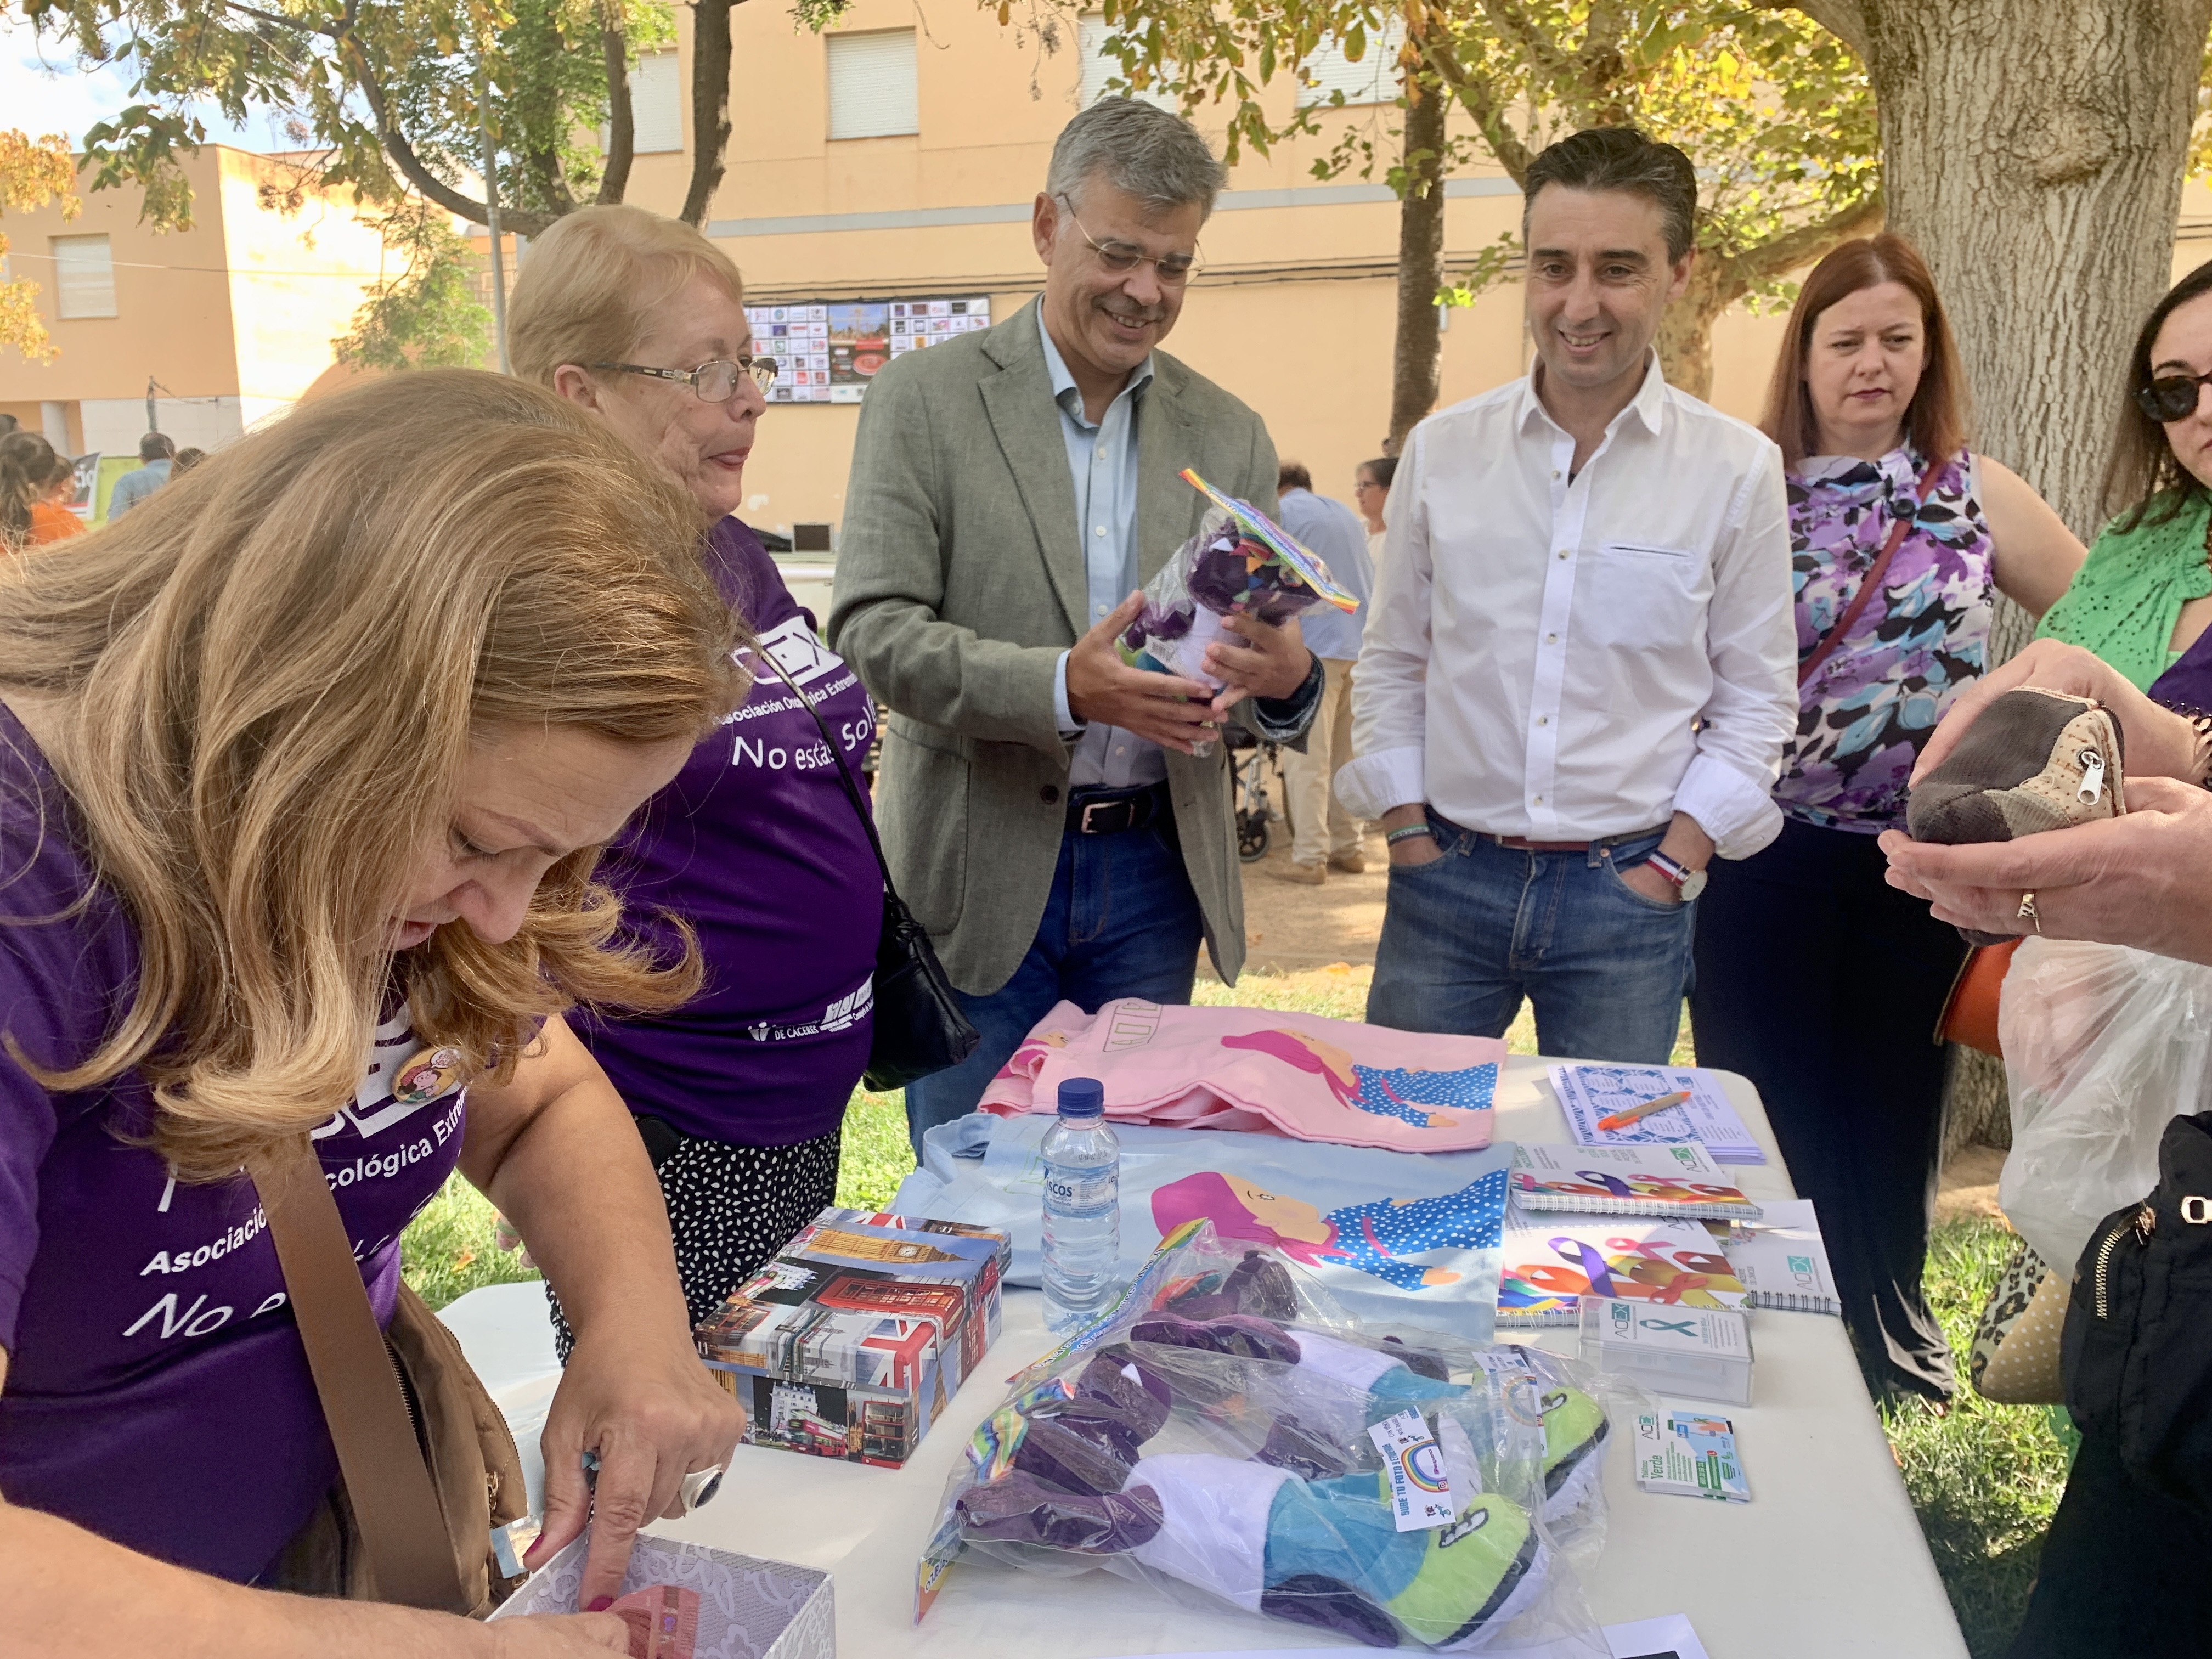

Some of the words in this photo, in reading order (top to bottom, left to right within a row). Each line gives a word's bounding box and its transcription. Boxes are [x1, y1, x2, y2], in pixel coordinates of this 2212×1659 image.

[718, 700, 783, 725] sociación
[732, 736, 787, 770] No
[775, 1030, 786, 1040] DE
[1670, 1147, 1702, 1172] AOEX
[1045, 1172, 1072, 1197] iscos
[139, 1203, 267, 1276] Asociació
[325, 1137, 433, 1191] cológica
[1787, 1256, 1814, 1291] AOEX
[122, 1293, 234, 1339] No
[1612, 1303, 1630, 1339] AOEX
[1393, 1466, 1403, 1484] FOTO
[1649, 1455, 1663, 1479] Verde
[1396, 1485, 1406, 1497] TU
[1398, 1497, 1410, 1516] SUBE
